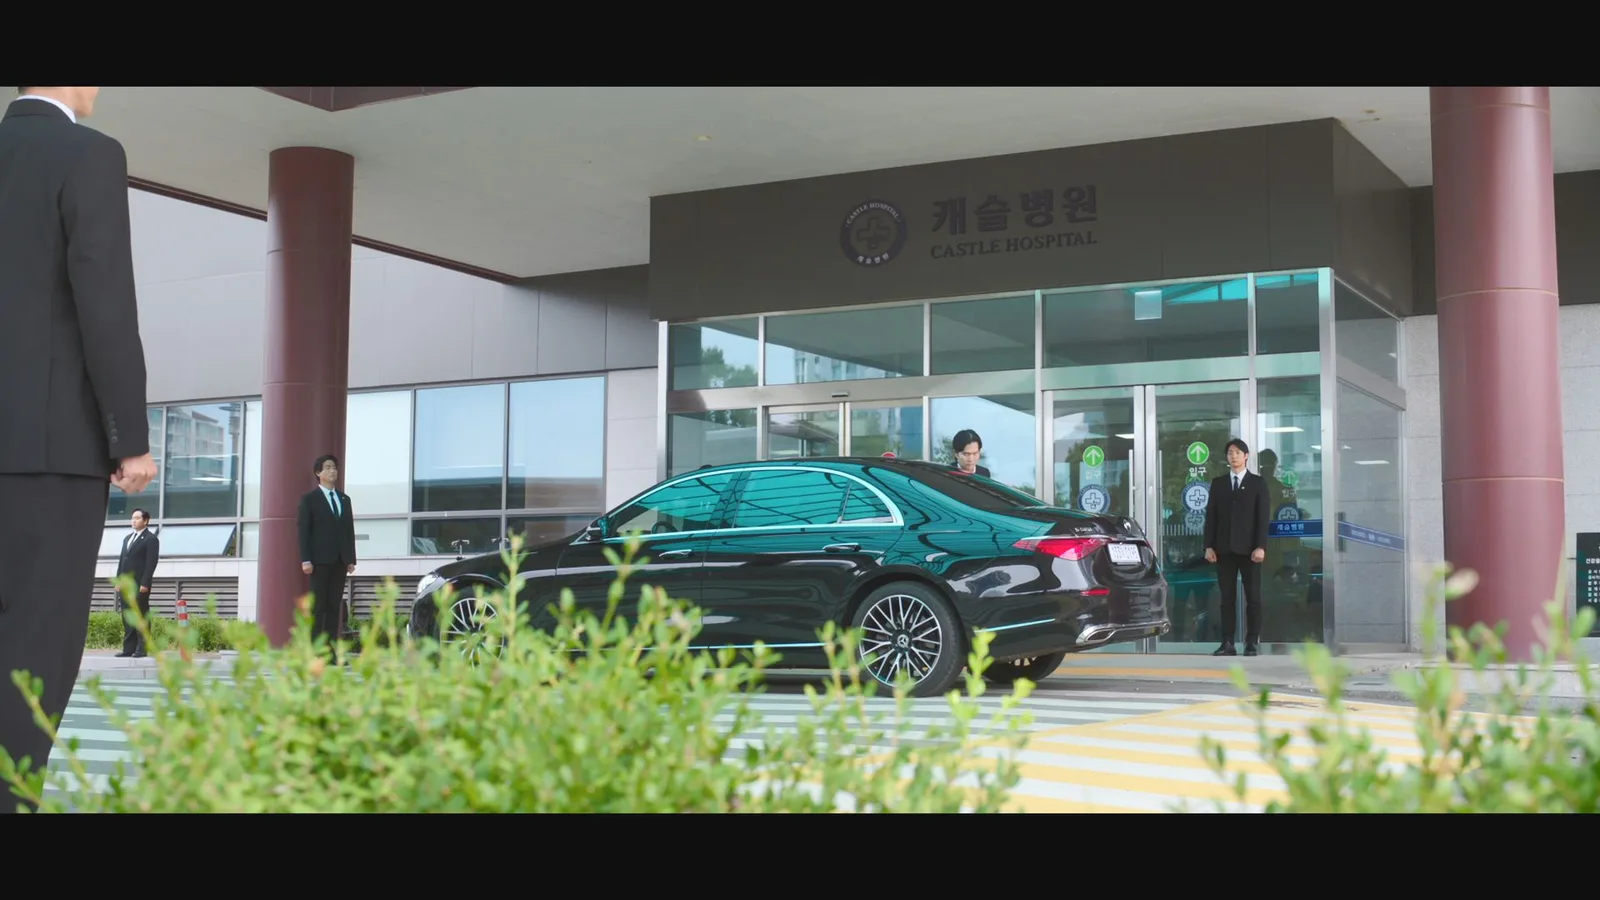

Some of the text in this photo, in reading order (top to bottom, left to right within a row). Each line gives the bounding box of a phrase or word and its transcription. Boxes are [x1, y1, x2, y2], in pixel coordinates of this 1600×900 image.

[846, 202, 901, 224] CASTLE HOSPITAL
[931, 184, 1098, 236] 캐슬병원
[930, 231, 1098, 259] CASTLE HOSPITAL
[1188, 466, 1207, 477] 입구
